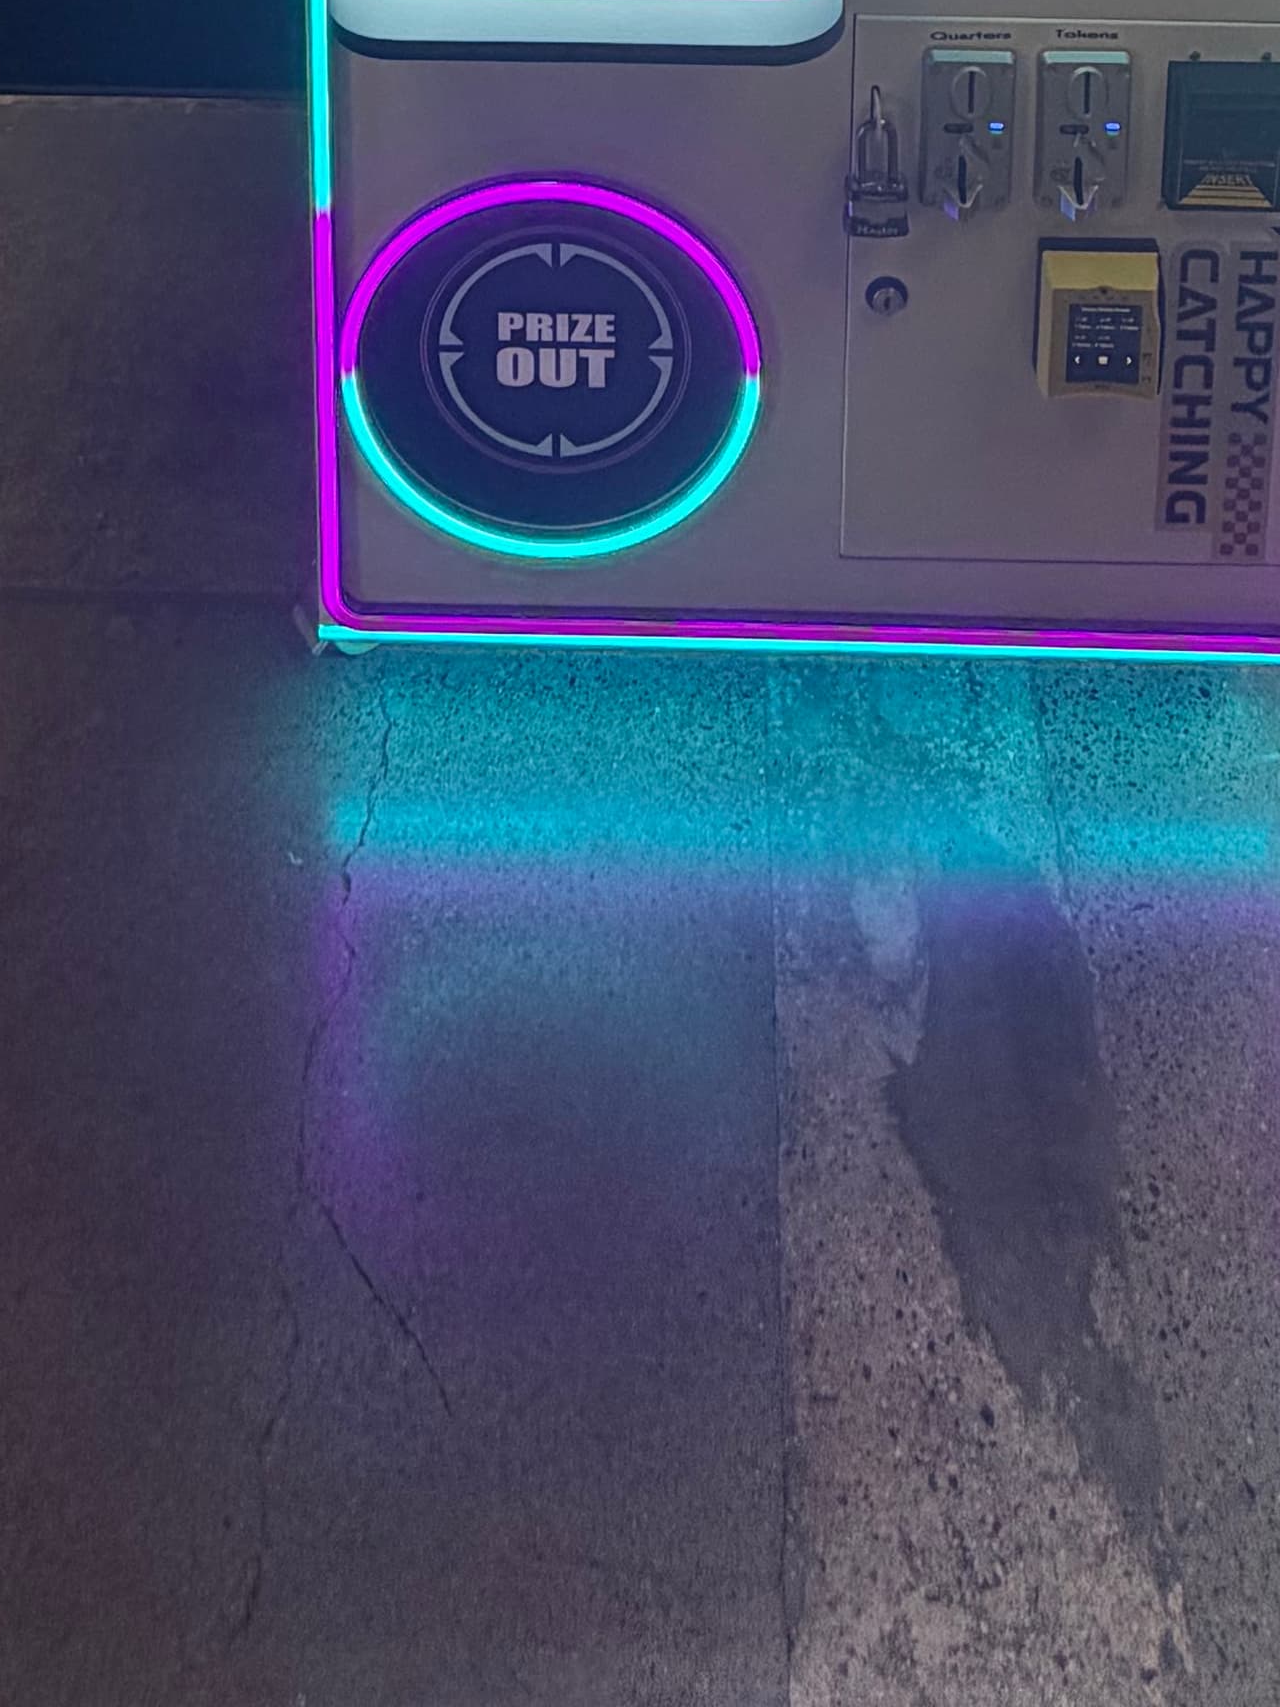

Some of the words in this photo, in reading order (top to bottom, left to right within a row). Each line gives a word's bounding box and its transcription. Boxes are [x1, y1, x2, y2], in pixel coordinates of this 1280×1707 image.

[930, 31, 1012, 41] Quarters
[1055, 29, 1119, 40] Tokens
[497, 311, 617, 343] PRIZE
[1230, 250, 1279, 424] HAPPY
[496, 346, 616, 389] OUT
[1165, 249, 1220, 525] CATCHING
